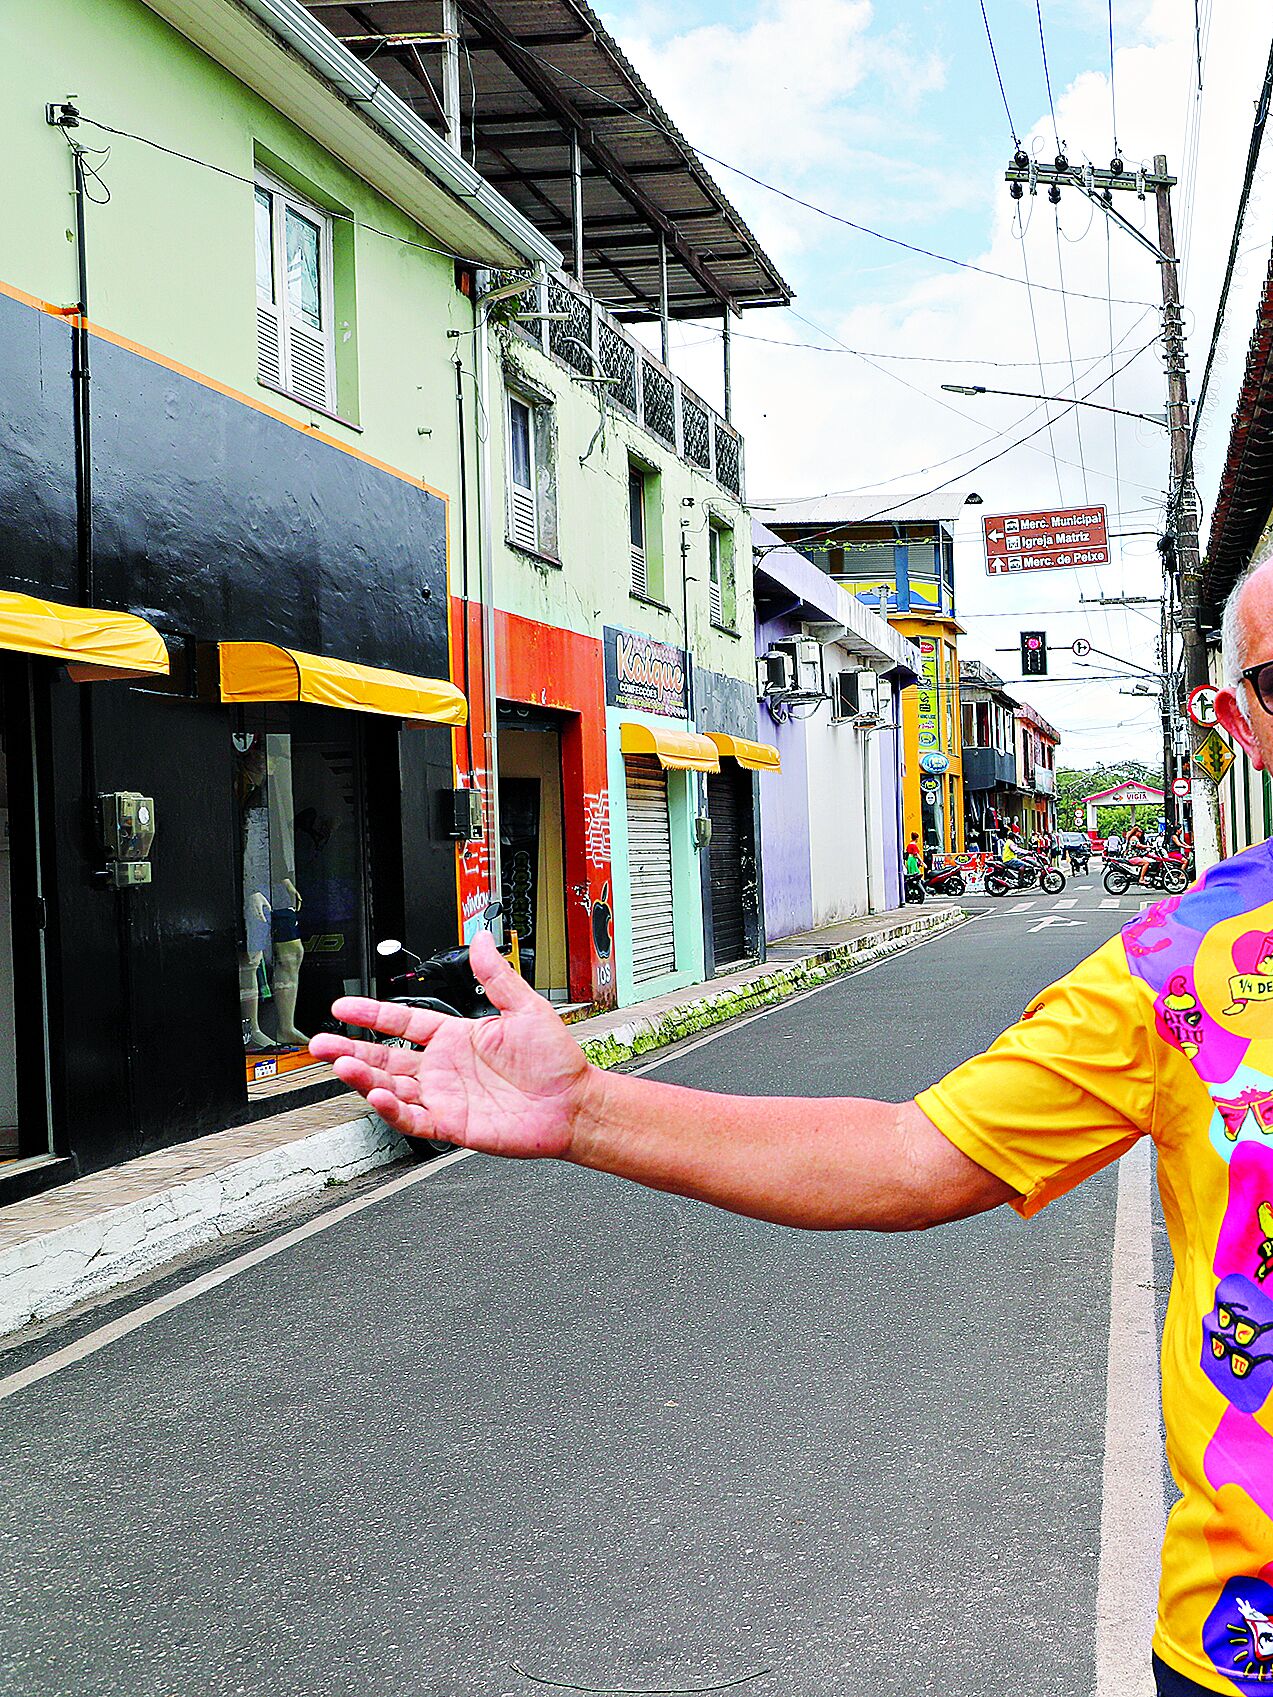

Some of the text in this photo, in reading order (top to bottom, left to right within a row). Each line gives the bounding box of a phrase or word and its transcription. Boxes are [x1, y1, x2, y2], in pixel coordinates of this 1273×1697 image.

[1020, 511, 1102, 531] Merc. Municipal
[1021, 531, 1091, 549] Igreja Matriz
[1023, 551, 1105, 568] Merc. de Peixe
[616, 633, 685, 702] Kaique
[1257, 981, 1273, 994] DE
